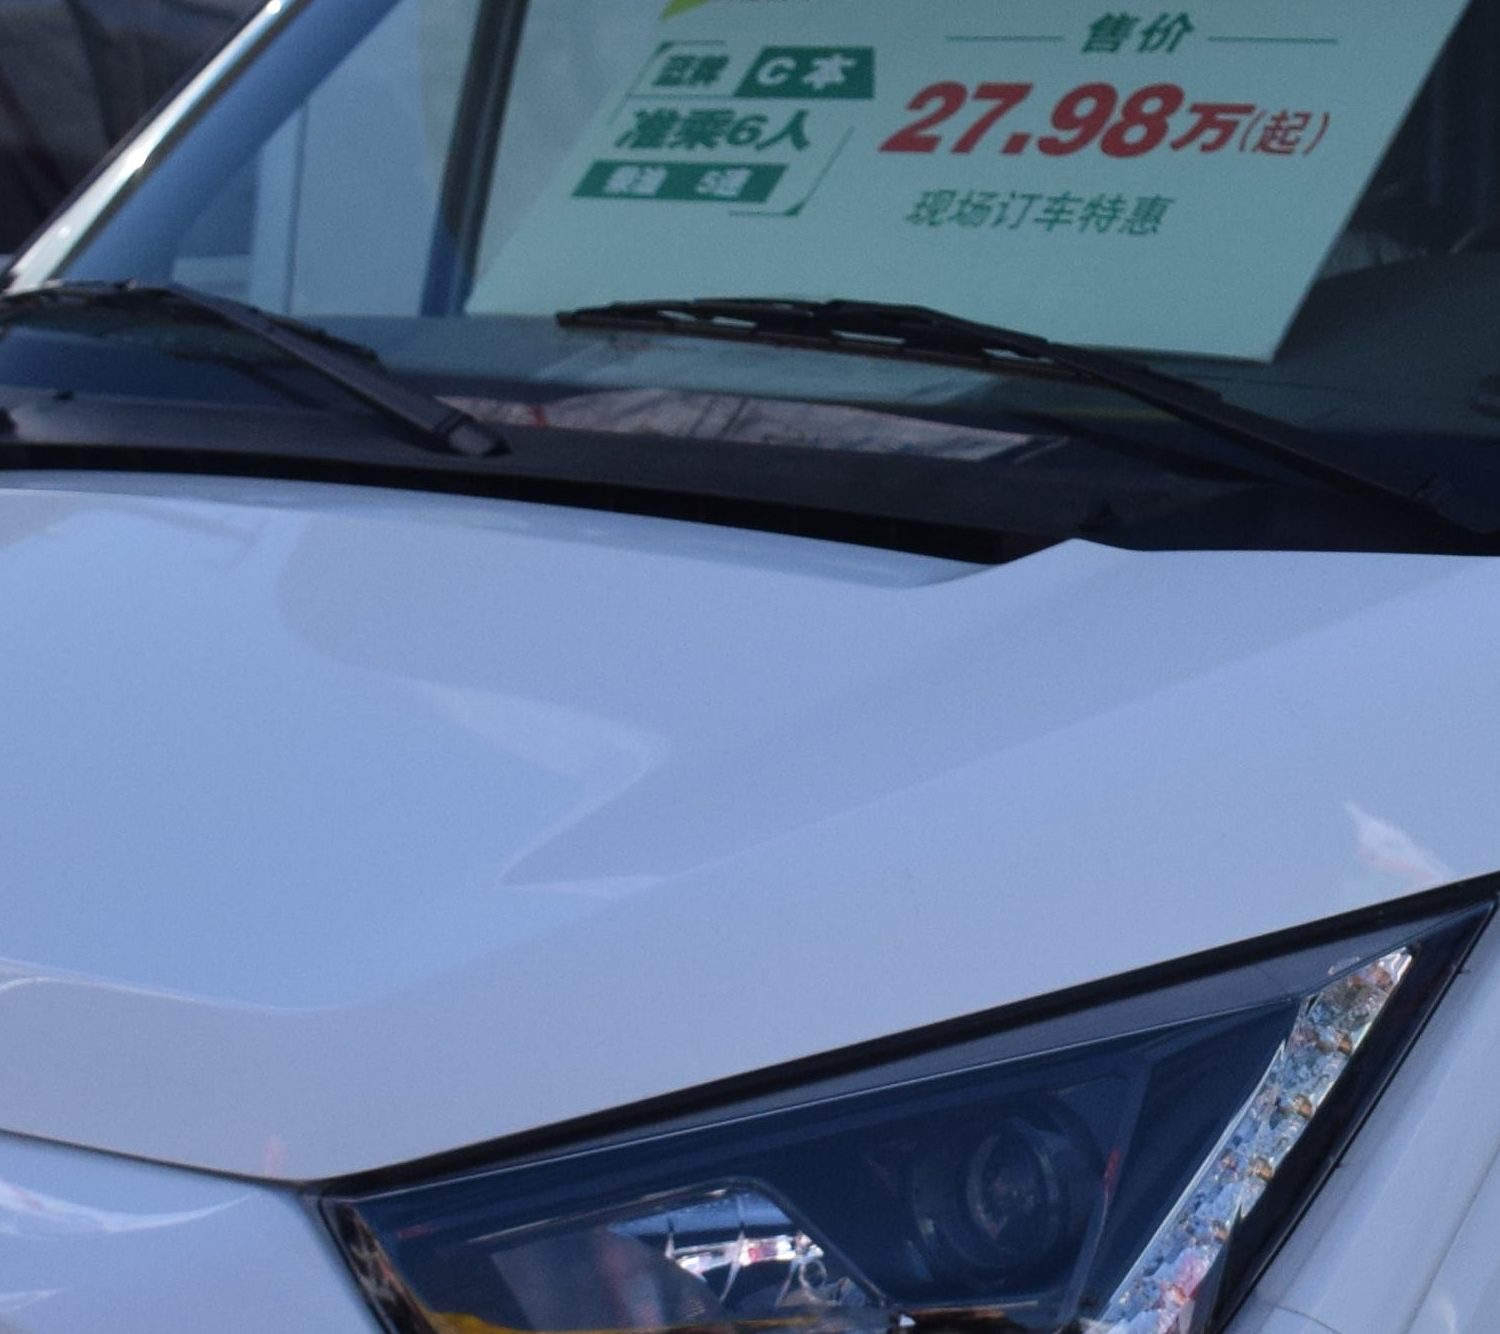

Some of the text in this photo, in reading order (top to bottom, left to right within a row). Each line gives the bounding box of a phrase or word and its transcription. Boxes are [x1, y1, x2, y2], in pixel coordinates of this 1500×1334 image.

[1080, 11, 1195, 54] 售价
[614, 107, 812, 153] 准乘6人
[904, 188, 1176, 237] 现场订车特惠
